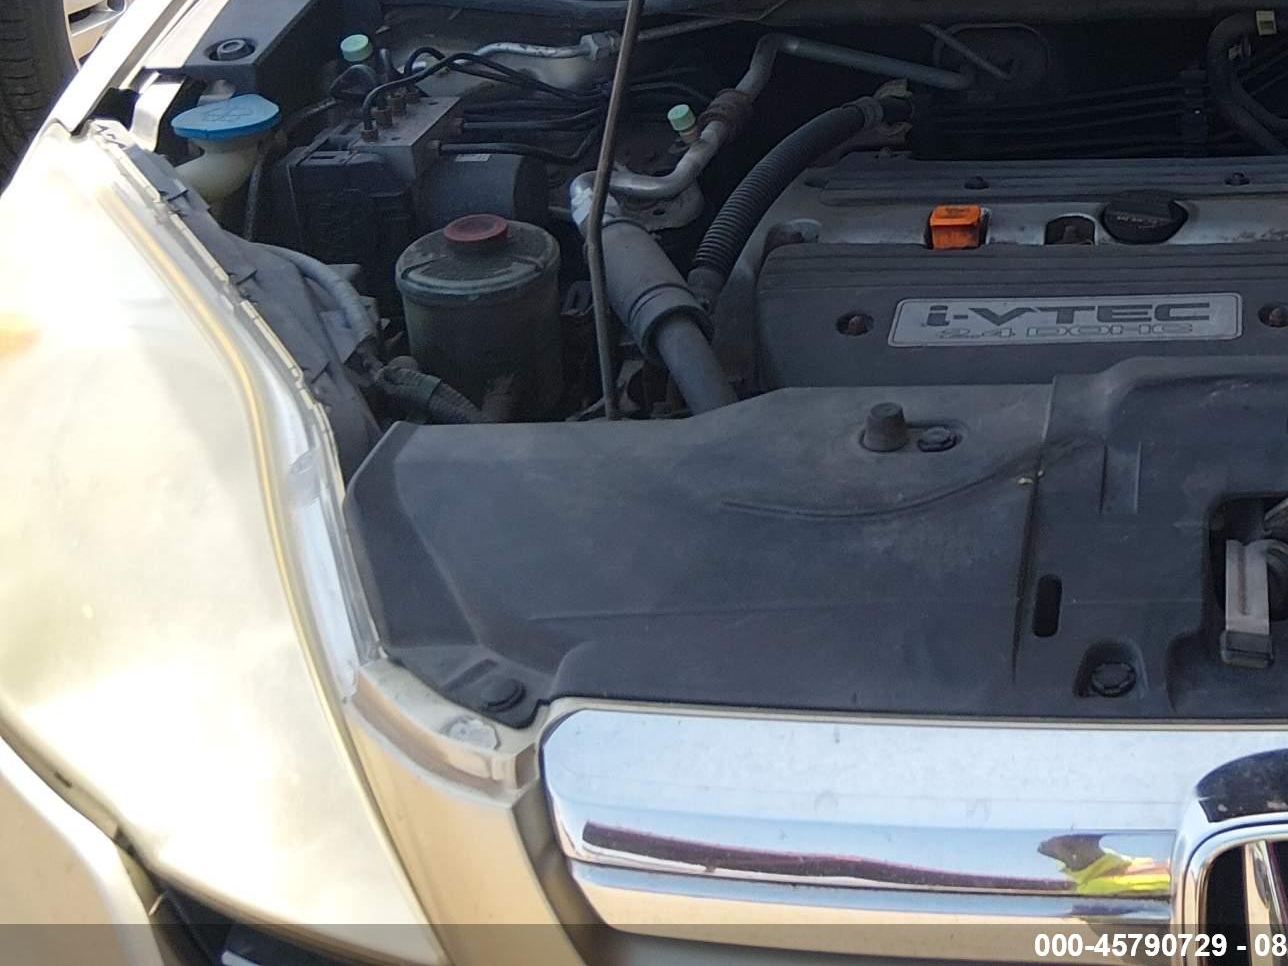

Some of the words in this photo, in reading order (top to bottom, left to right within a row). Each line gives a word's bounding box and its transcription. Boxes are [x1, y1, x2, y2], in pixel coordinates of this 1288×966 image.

[926, 302, 1210, 327] i-VTEC
[939, 326, 1016, 340] 2.4
[1026, 323, 1194, 338] DOHC
